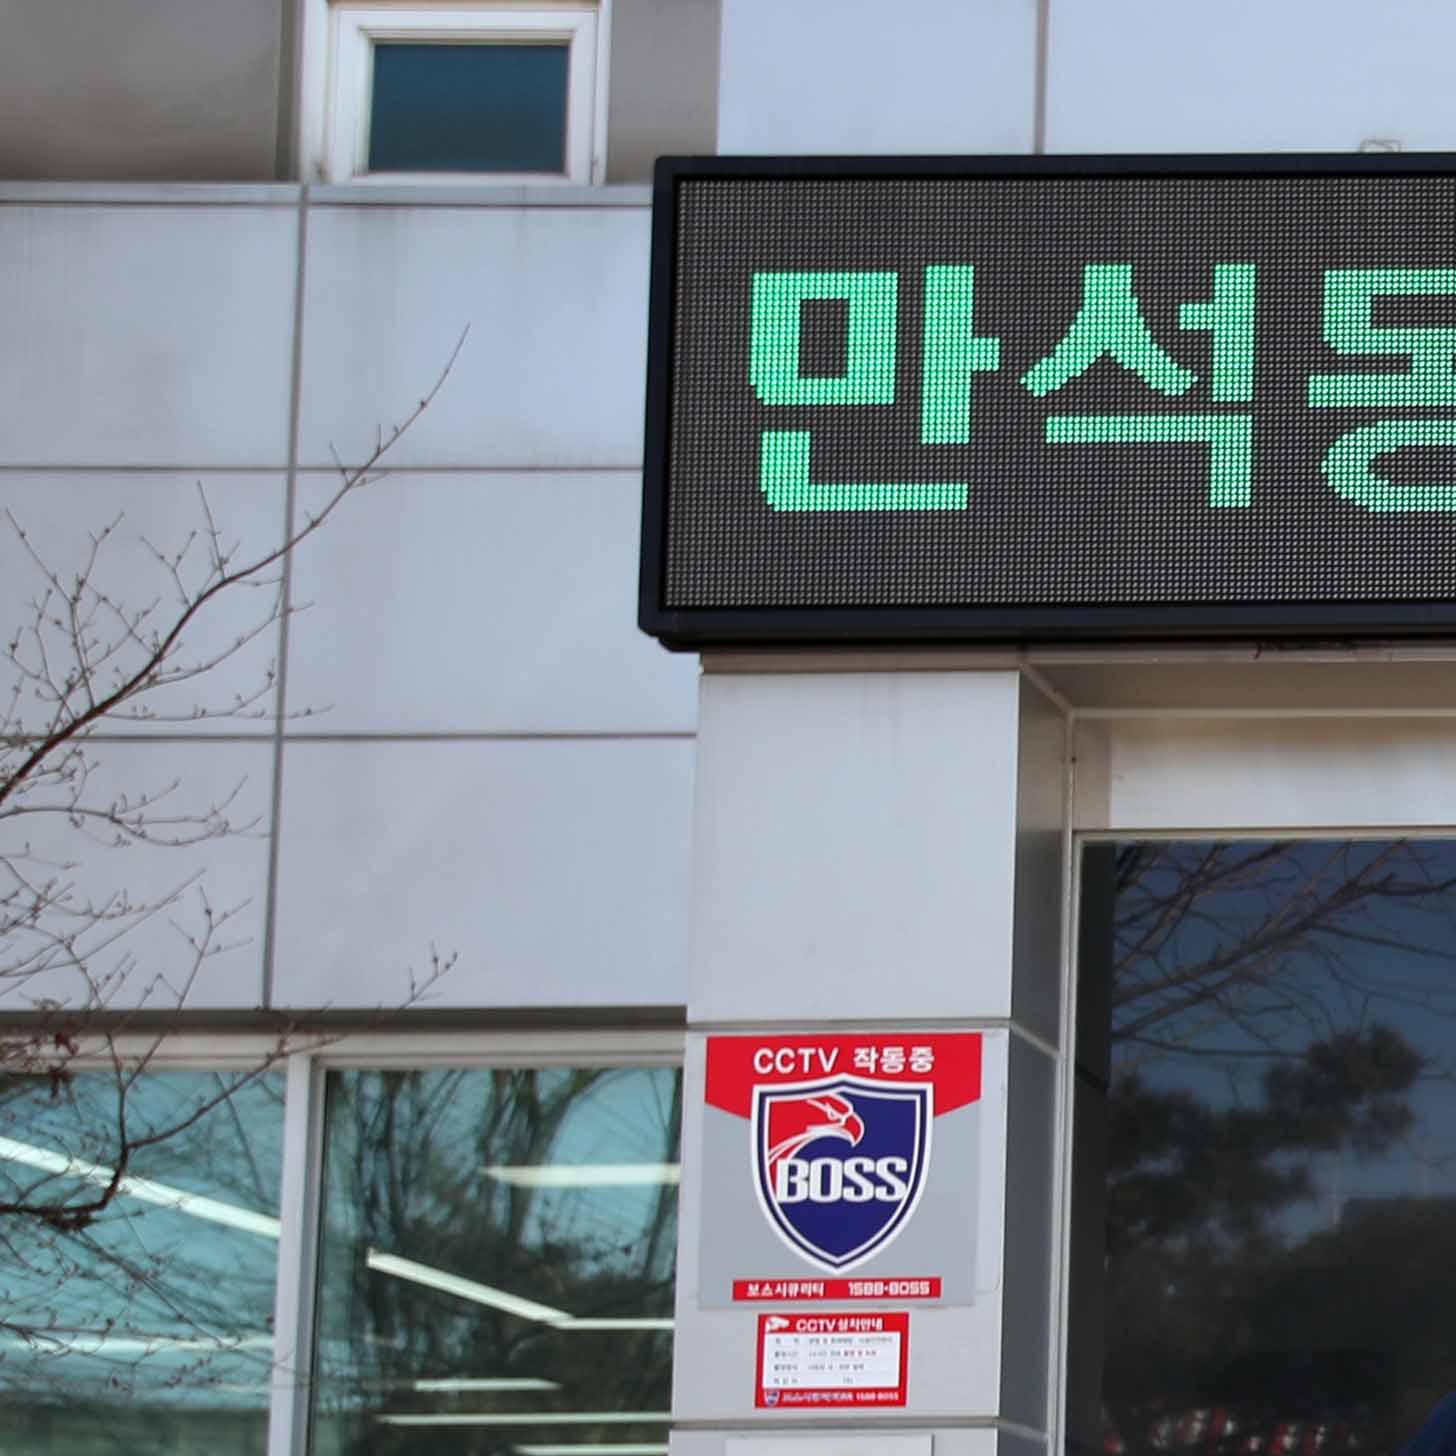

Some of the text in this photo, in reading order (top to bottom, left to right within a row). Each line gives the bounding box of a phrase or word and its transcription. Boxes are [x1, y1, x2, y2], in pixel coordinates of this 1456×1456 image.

[753, 1046, 935, 1074] CCTV 작동중
[776, 1156, 908, 1203] BOSS
